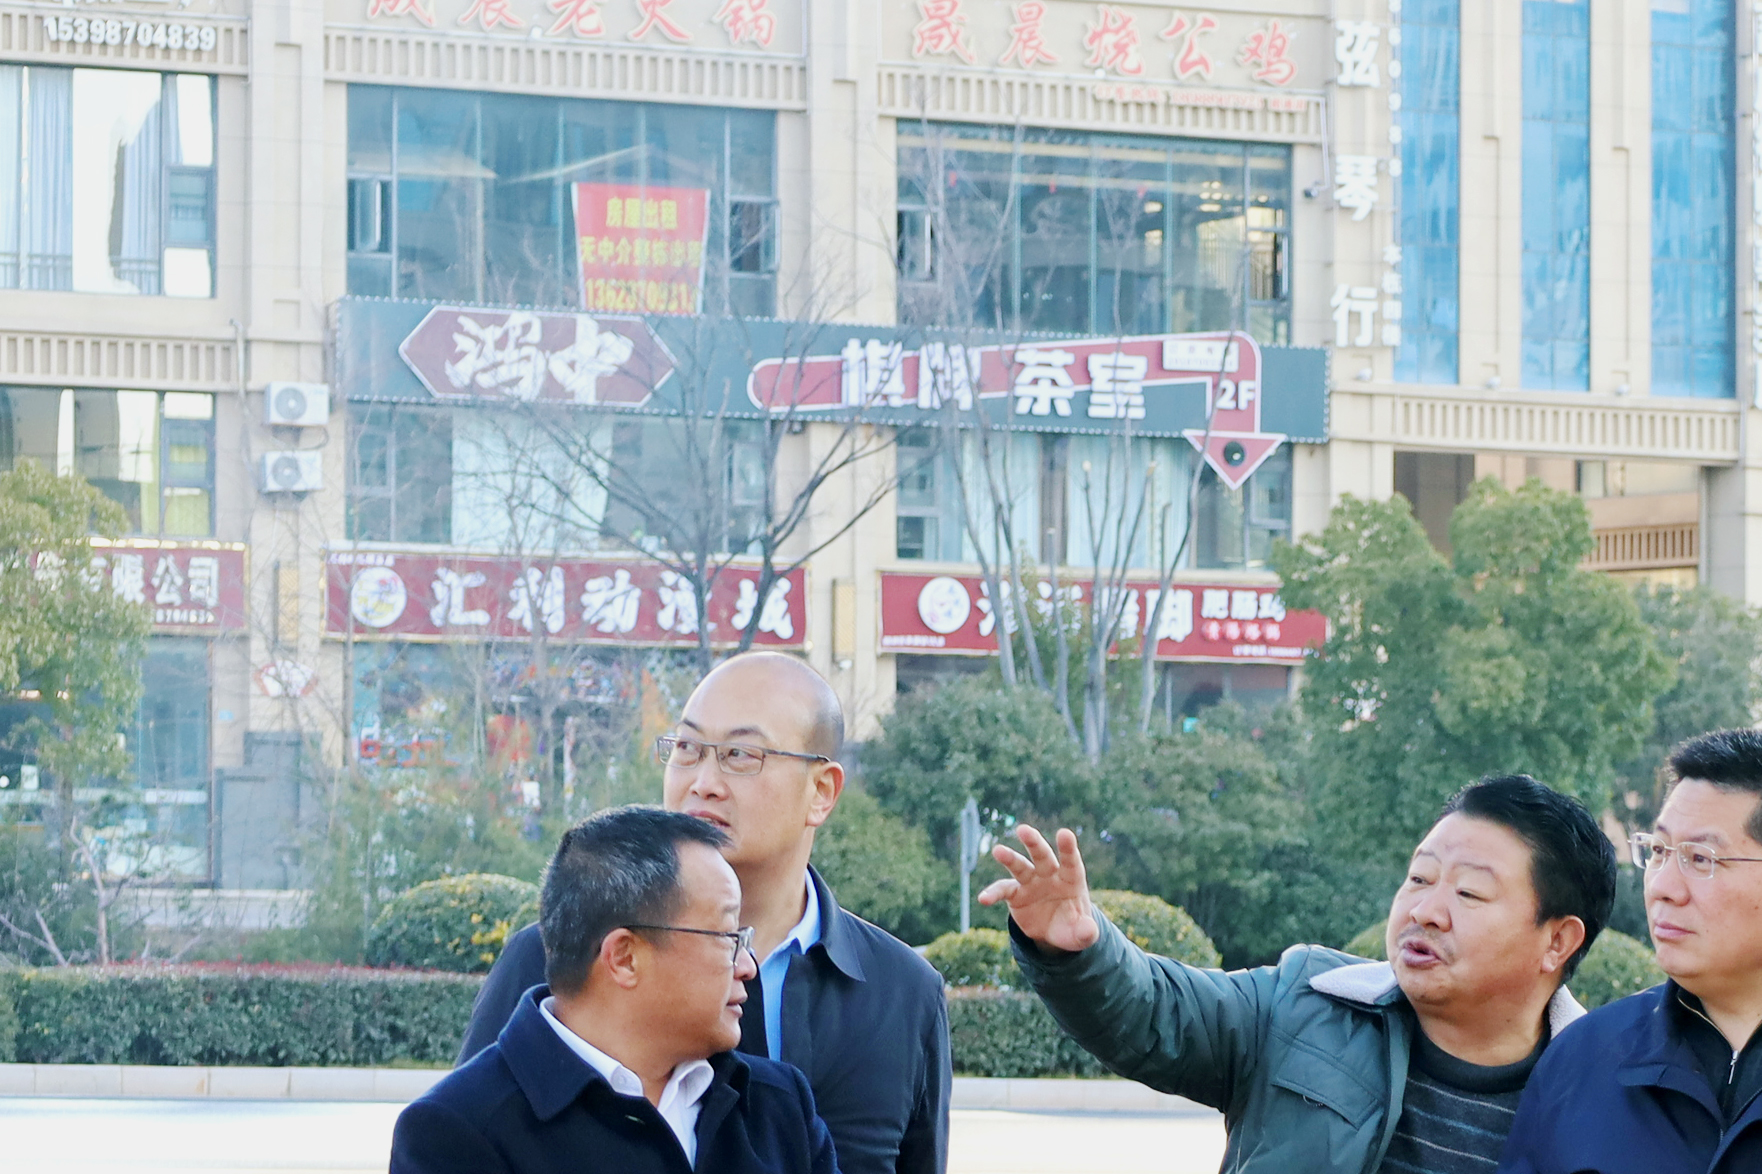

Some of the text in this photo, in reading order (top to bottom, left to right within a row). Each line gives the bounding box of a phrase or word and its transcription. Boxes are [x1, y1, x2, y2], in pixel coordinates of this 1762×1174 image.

[44, 16, 216, 50] 15398704839
[1331, 20, 1380, 347] 弦琴行
[605, 197, 678, 230] 房屋出租
[841, 338, 1148, 419] 棋牌茶室
[1216, 379, 1256, 411] 2F
